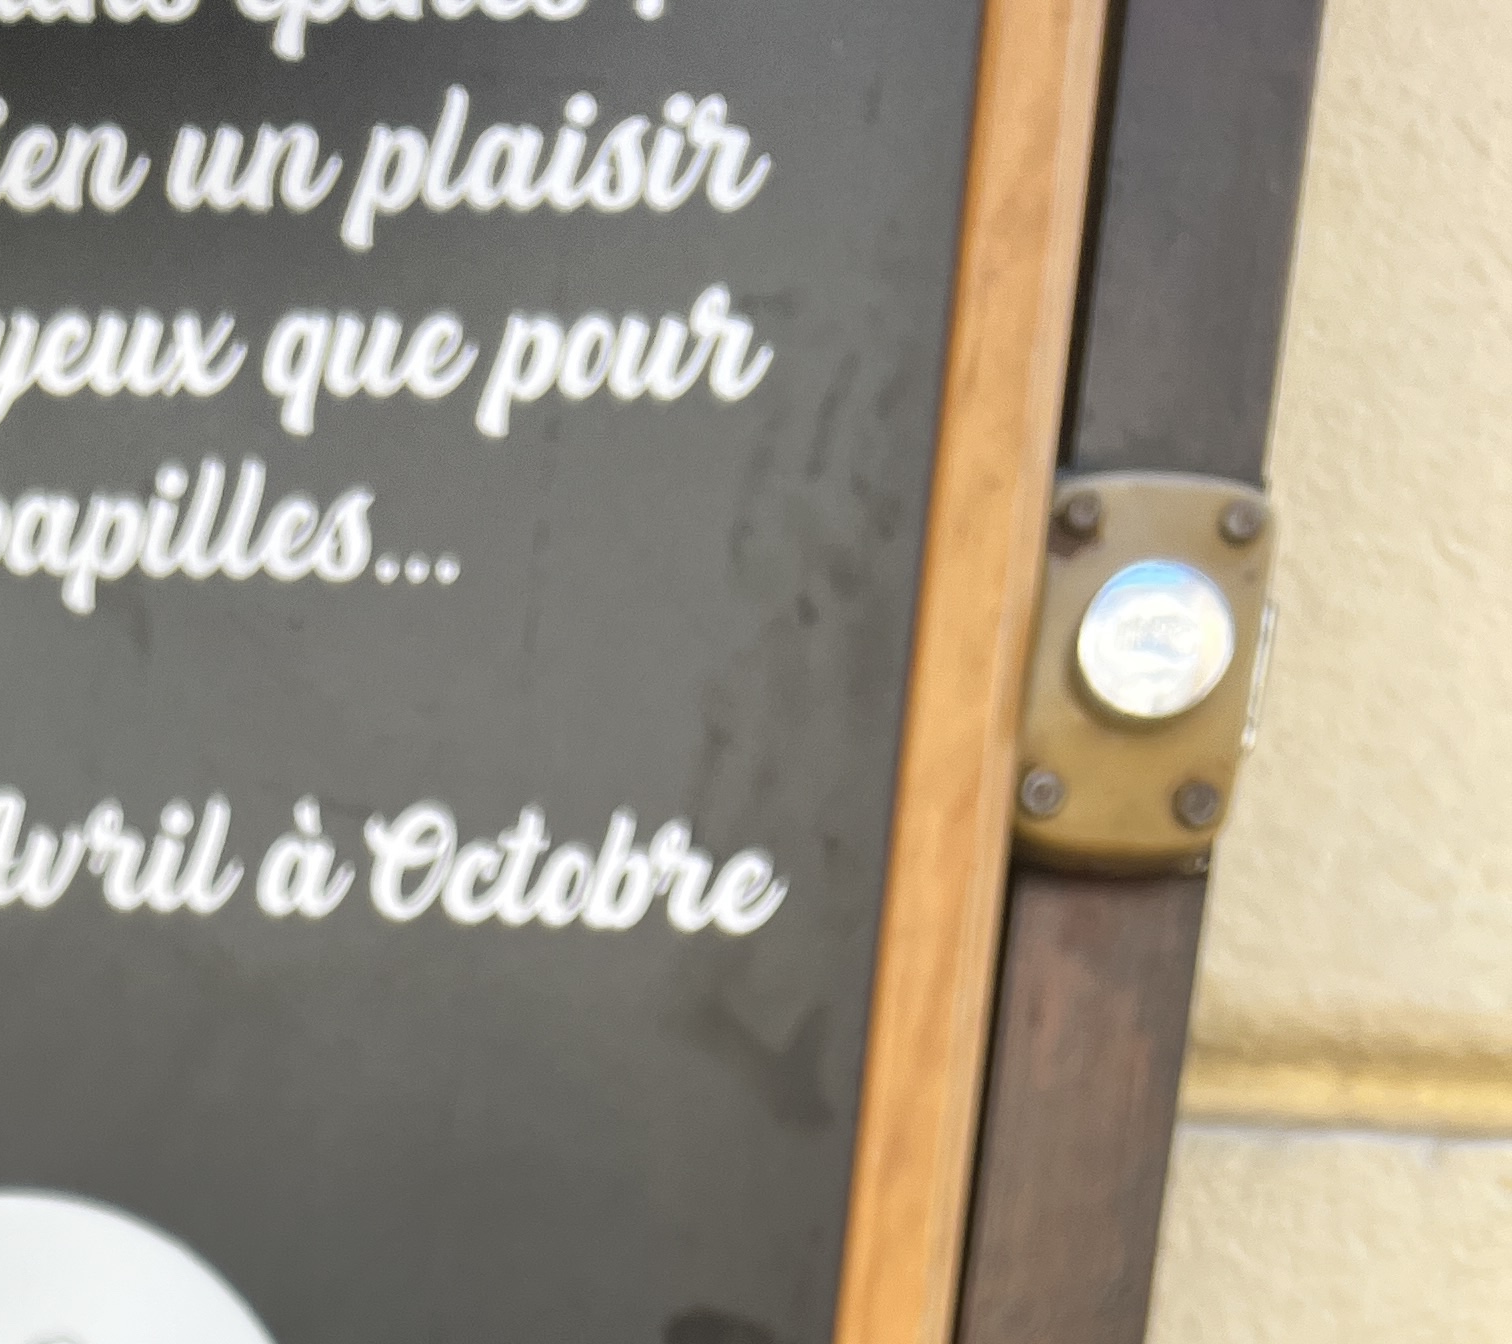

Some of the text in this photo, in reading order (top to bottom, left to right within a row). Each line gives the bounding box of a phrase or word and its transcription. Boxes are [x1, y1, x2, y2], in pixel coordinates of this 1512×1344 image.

[166, 124, 343, 211] un
[339, 85, 773, 251] plaisir
[261, 311, 480, 437] que
[474, 284, 775, 439] pour
[255, 798, 356, 918] à
[363, 803, 788, 935] Octobre
